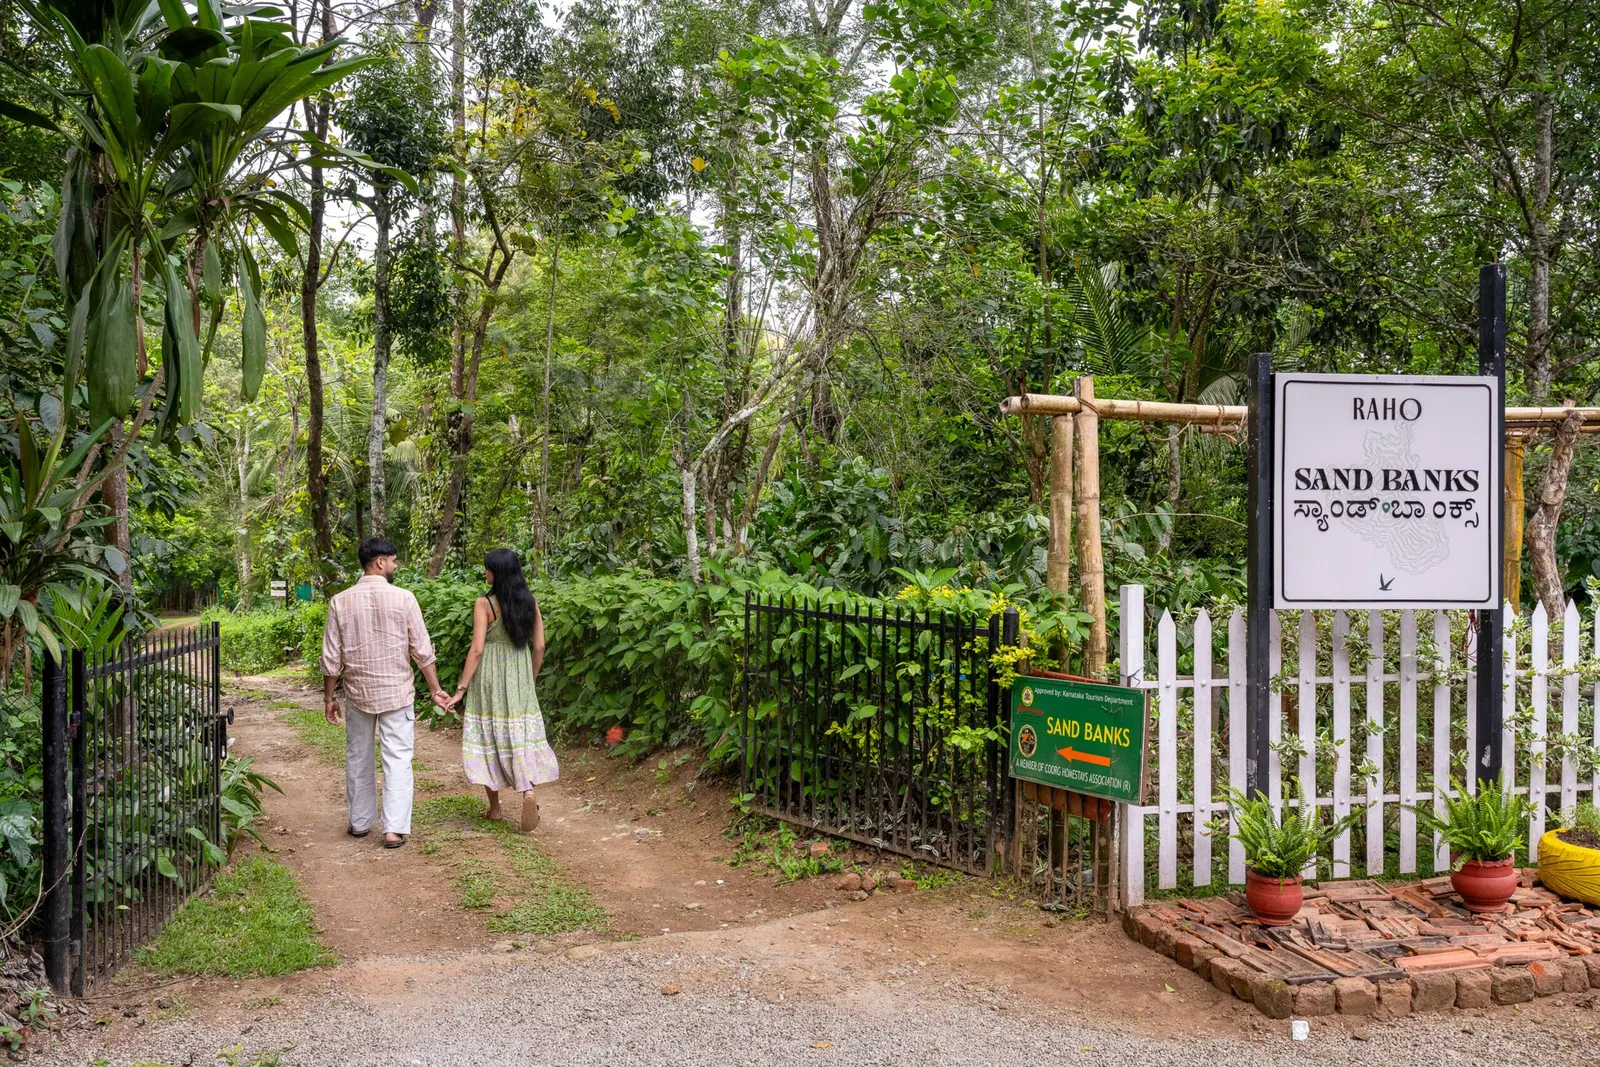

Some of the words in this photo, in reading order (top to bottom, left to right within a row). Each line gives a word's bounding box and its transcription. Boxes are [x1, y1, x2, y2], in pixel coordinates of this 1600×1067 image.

[1352, 397, 1422, 421] RAHO
[1294, 468, 1373, 491] SAND
[1381, 469, 1479, 492] BANKS
[1034, 687, 1054, 696] Approved
[1054, 689, 1062, 697] by:
[1062, 690, 1084, 700] Karnataka
[1085, 692, 1104, 702] Tourism
[1104, 695, 1133, 706] Department
[1046, 716, 1080, 739] SAND
[1084, 723, 1131, 748] BANKS
[1019, 759, 1038, 771] MEMBER
[1037, 762, 1044, 772] OF
[1044, 763, 1061, 776] COORG
[1061, 767, 1089, 783] HOMESTAYS
[1088, 773, 1122, 789] ASSOCIATION
[1122, 780, 1131, 793] (R)
